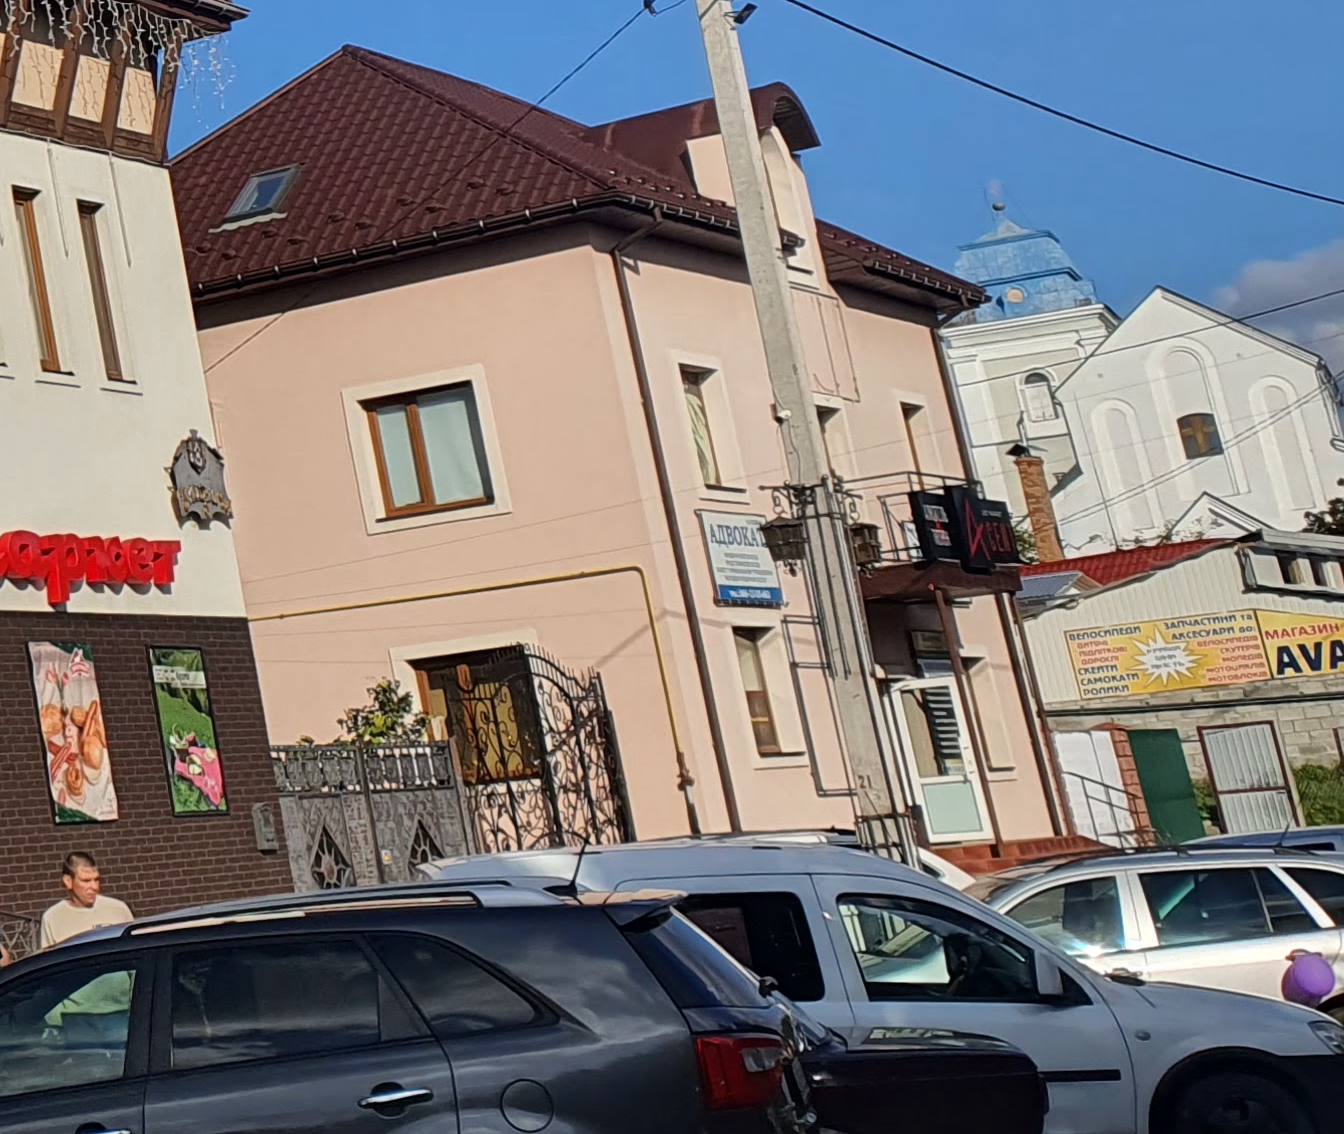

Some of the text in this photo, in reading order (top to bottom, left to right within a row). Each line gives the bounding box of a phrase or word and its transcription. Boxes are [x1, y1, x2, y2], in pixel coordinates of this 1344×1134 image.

[1164, 614, 1236, 630] ЗАПЧАСТИНИ
[1069, 626, 1142, 641] ВЕЛОСИПЕДИ
[1171, 626, 1235, 641] АКСЕСУАРИ
[1265, 623, 1340, 641] МАГАЗИН
[1080, 673, 1140, 686] САМОКАТИ
[1083, 685, 1130, 696] РОЛИКИ
